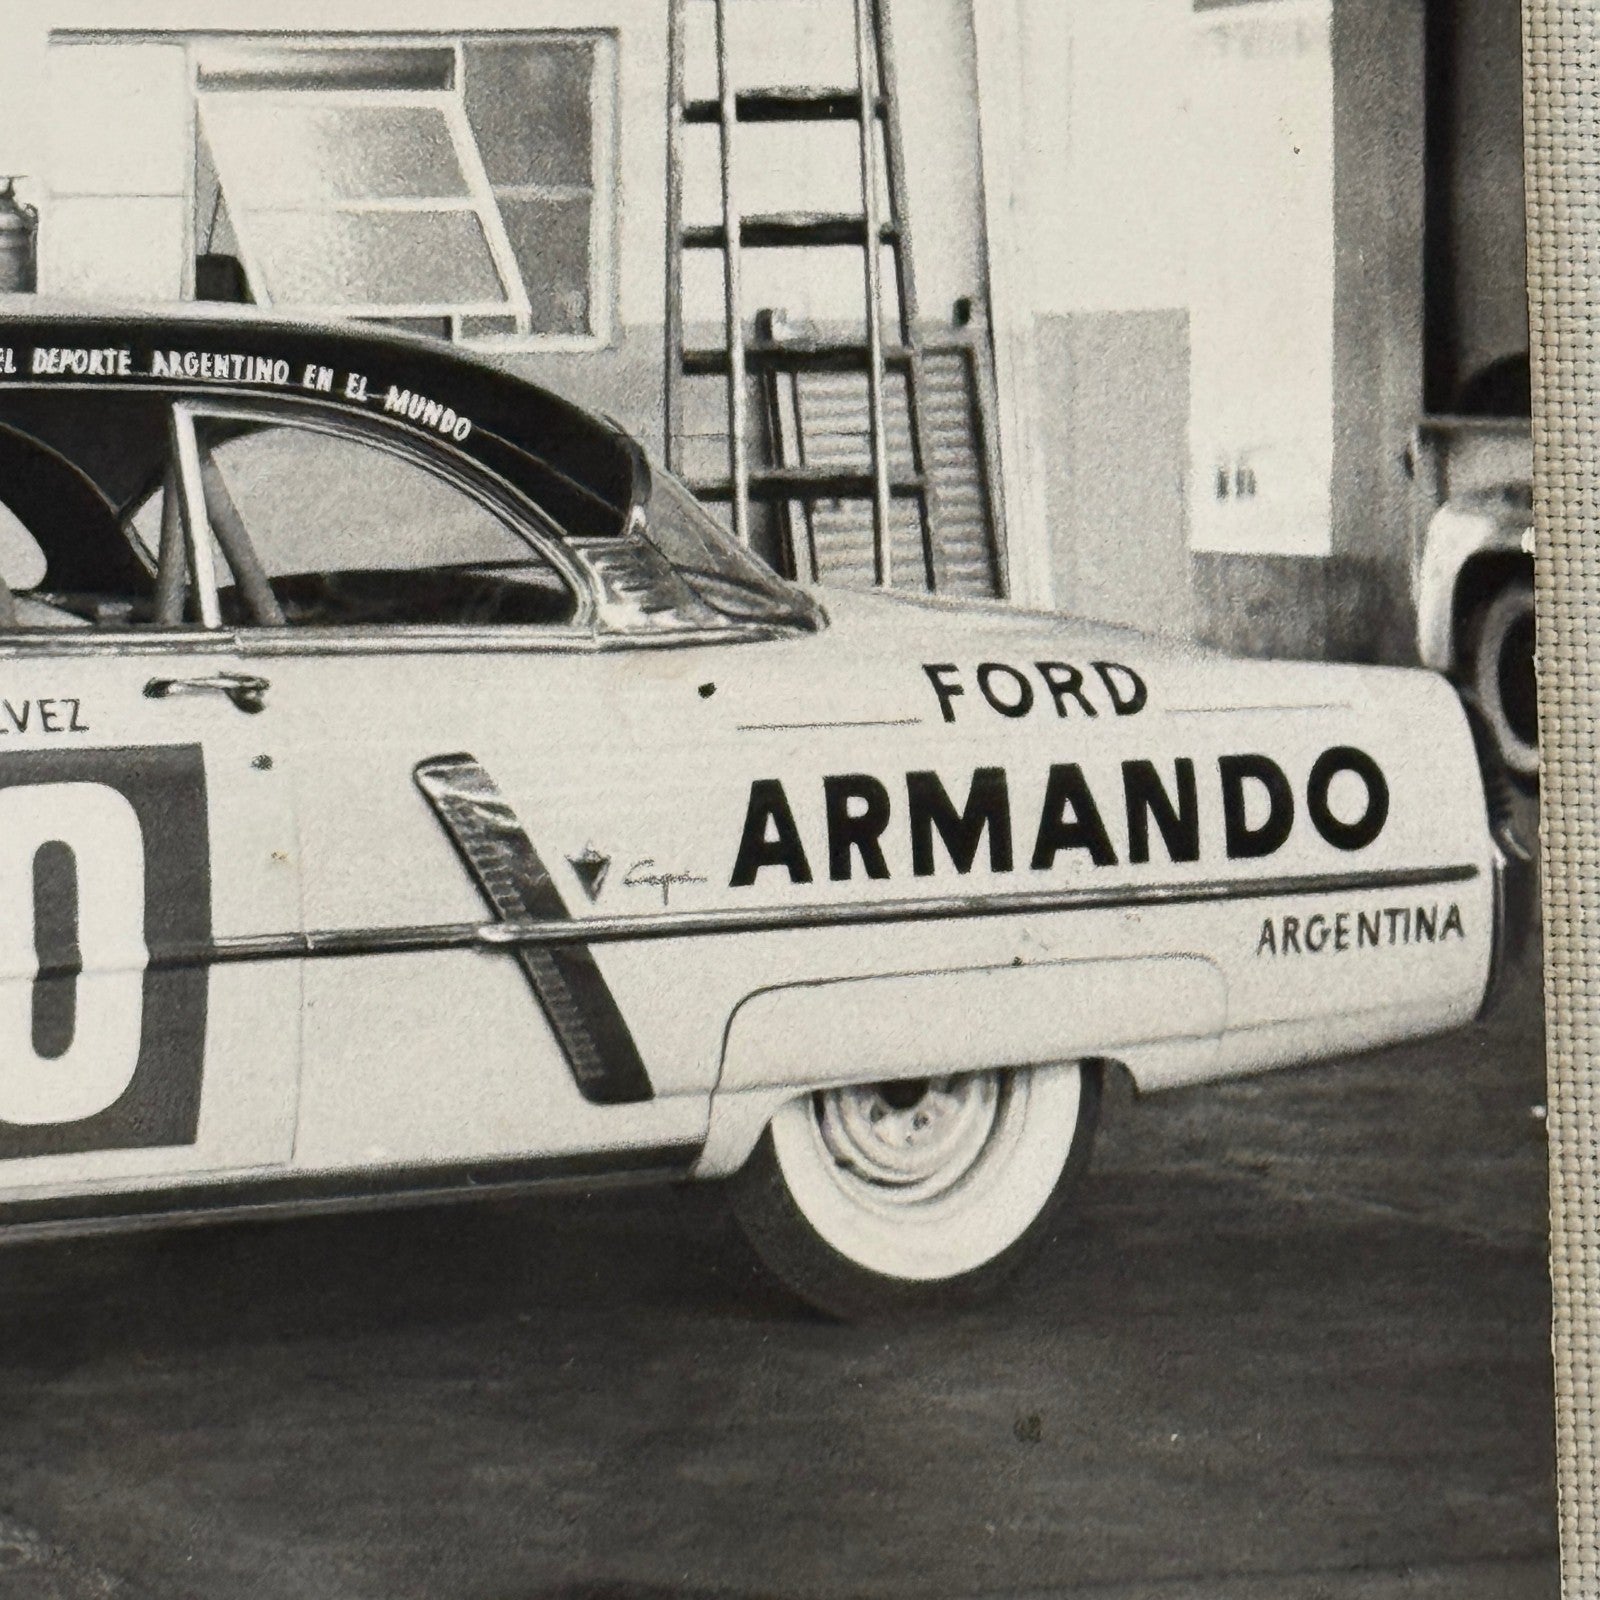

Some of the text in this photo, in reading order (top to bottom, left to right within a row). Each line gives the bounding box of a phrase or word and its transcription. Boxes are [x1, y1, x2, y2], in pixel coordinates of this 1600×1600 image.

[32, 346, 132, 376] DEPORTE
[150, 350, 290, 385] ARGENTINO
[302, 363, 334, 392] EN
[345, 372, 368, 402] EL
[384, 385, 472, 442] MUNDO
[921, 660, 1148, 723] FORD
[728, 745, 1390, 888] ARMANDO
[1256, 902, 1465, 957] ARGENTINA
